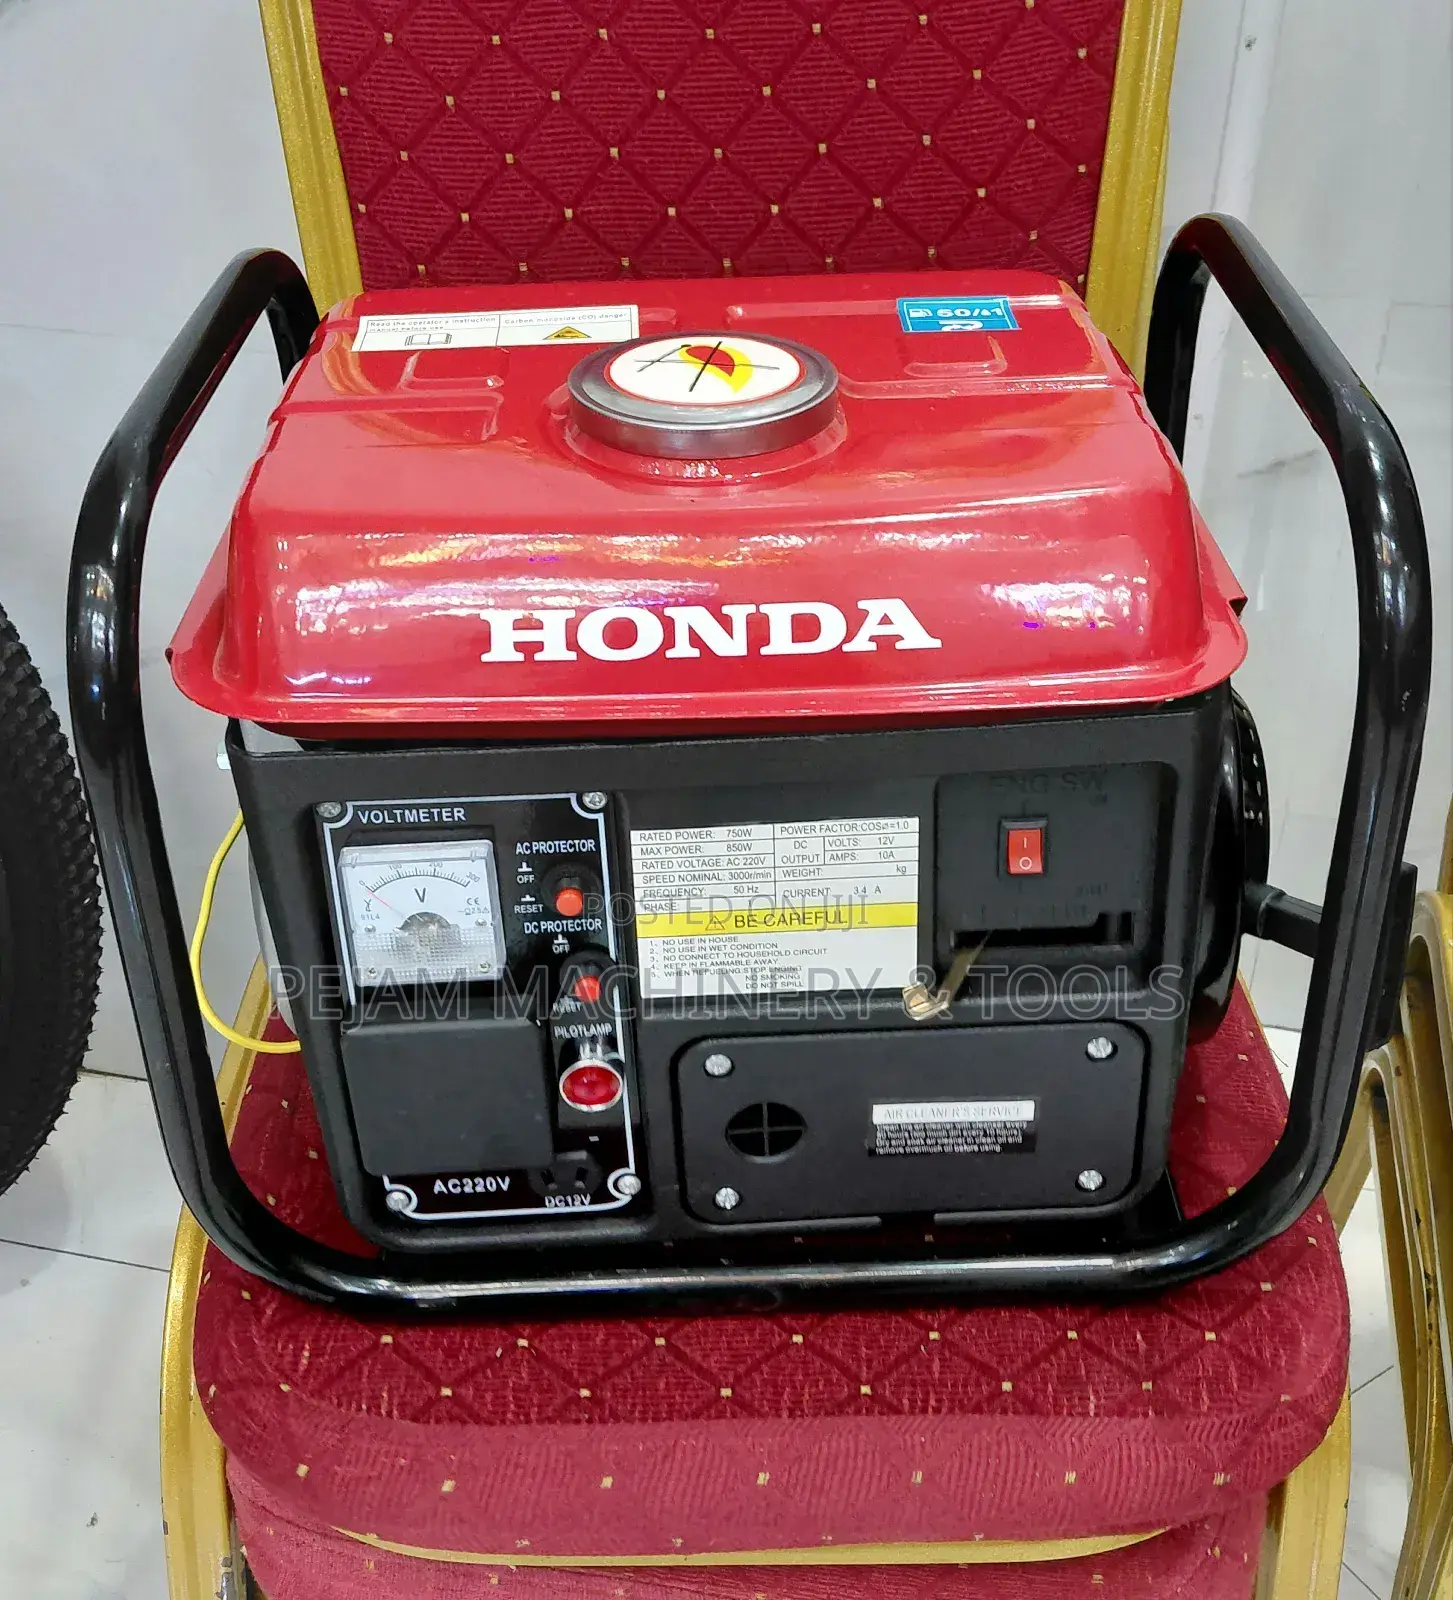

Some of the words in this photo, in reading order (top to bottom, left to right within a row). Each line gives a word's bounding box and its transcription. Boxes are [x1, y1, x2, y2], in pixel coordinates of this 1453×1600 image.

[452, 316, 496, 324] instruction
[599, 312, 628, 320] danger
[479, 597, 943, 663] HONDA
[357, 807, 466, 825] VOLTMETER
[640, 831, 672, 841] RATED
[675, 829, 715, 840] POWER:
[726, 828, 752, 838] 750W
[780, 824, 817, 835] POWER
[515, 842, 532, 856] AC
[533, 839, 596, 854] PROTECTOR
[793, 840, 808, 850] DC
[827, 837, 861, 848] VOLTS:
[877, 836, 895, 846] 12V
[640, 846, 662, 856] MAX
[665, 844, 704, 855] POWER:
[726, 842, 752, 853] 850W
[781, 853, 821, 865] OUTPUT
[828, 851, 858, 862] AMPS:
[878, 850, 896, 860] 10A
[641, 860, 674, 871] RATED
[677, 858, 724, 870] VOLTAGE:
[726, 857, 741, 867] AC
[743, 855, 766, 866] 220V
[466, 871, 480, 883] 300
[642, 874, 676, 885] SPEED
[678, 871, 725, 883] NOMINAL:
[728, 869, 772, 881] 3000r/min
[782, 867, 823, 879] WEIGHT:
[896, 864, 907, 875] kg
[516, 873, 536, 885] OFF
[414, 887, 426, 903] V
[643, 886, 707, 899] FREQUENCY:
[733, 885, 745, 895] 50
[747, 884, 760, 894] Hz
[873, 885, 882, 894] A
[514, 903, 544, 915] RESET
[644, 901, 680, 912] PHASE:
[734, 914, 758, 929] BE
[763, 909, 848, 929] CAREFUL
[523, 921, 539, 935] DC
[540, 918, 603, 934] PROTECTOR
[662, 938, 676, 947] NO
[677, 937, 696, 946] USE
[697, 937, 707, 945] IN
[708, 936, 739, 945] HOUSE
[552, 943, 570, 955] OFF
[662, 946, 676, 954] NO
[678, 945, 696, 953] USE
[698, 944, 707, 952] IN
[709, 943, 728, 952] WET
[730, 942, 779, 951] CONDITION
[663, 954, 676, 962] NO
[680, 953, 721, 962] CONNECT
[723, 951, 735, 960] TO
[736, 949, 791, 959] HOUSEHOLD
[793, 948, 829, 956] CIRCUIT
[664, 962, 687, 970] KEEP
[688, 961, 698, 969] IN
[699, 959, 752, 968] FLAMMABLE
[753, 958, 779, 966] AWAY
[663, 969, 690, 978] WHEN
[743, 966, 766, 975] STOP
[745, 974, 758, 982] NO
[760, 973, 801, 981] SMOKING
[745, 982, 759, 990] DO
[761, 981, 778, 989] NOT
[780, 980, 804, 988] SPILL
[883, 1108, 903, 1121] AIR
[433, 1176, 511, 1194] AC220V
